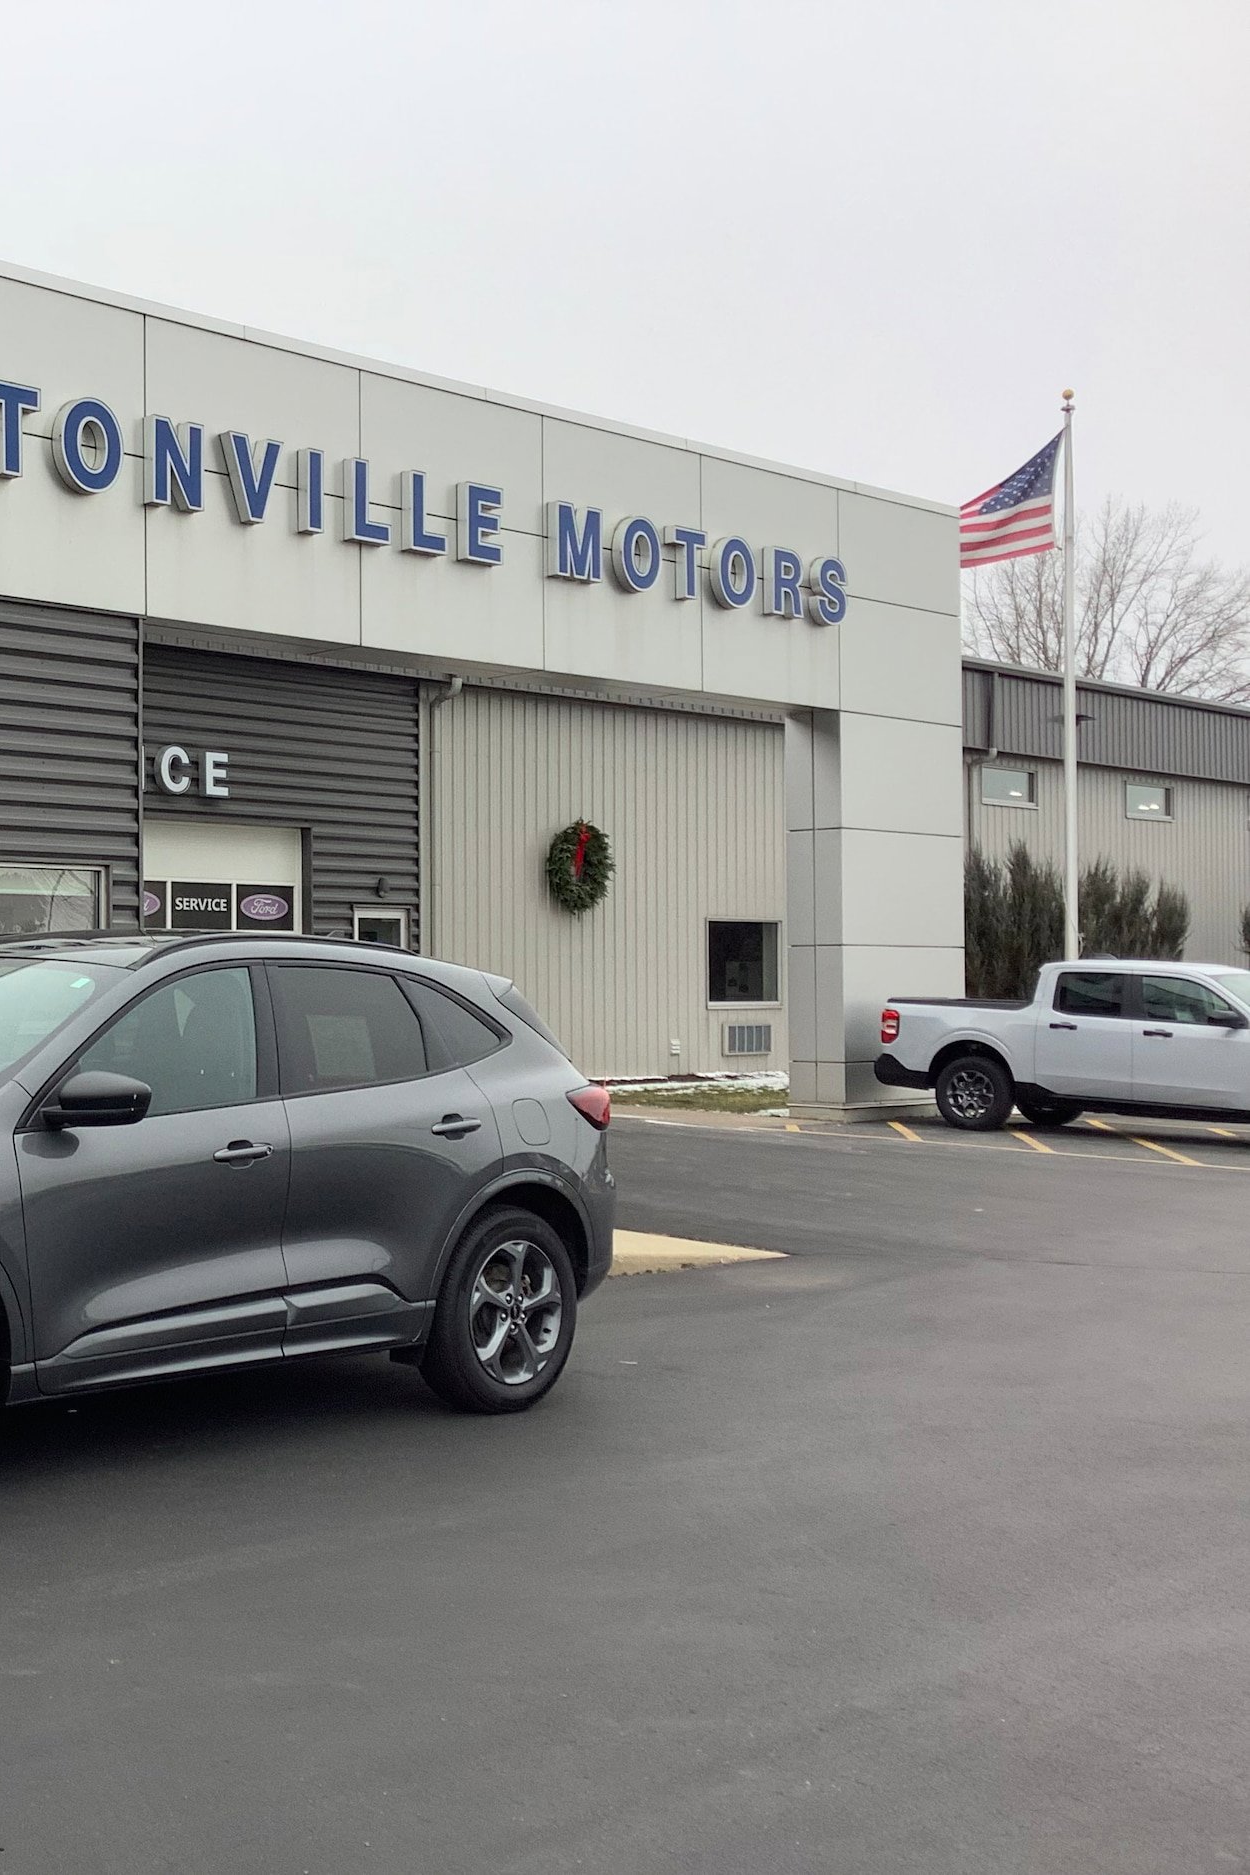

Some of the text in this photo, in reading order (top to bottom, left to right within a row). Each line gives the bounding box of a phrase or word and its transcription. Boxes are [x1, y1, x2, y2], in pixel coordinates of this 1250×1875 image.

[547, 501, 849, 626] MOTORS
[174, 897, 228, 912] SERVICE
[250, 898, 278, 915] Ford
